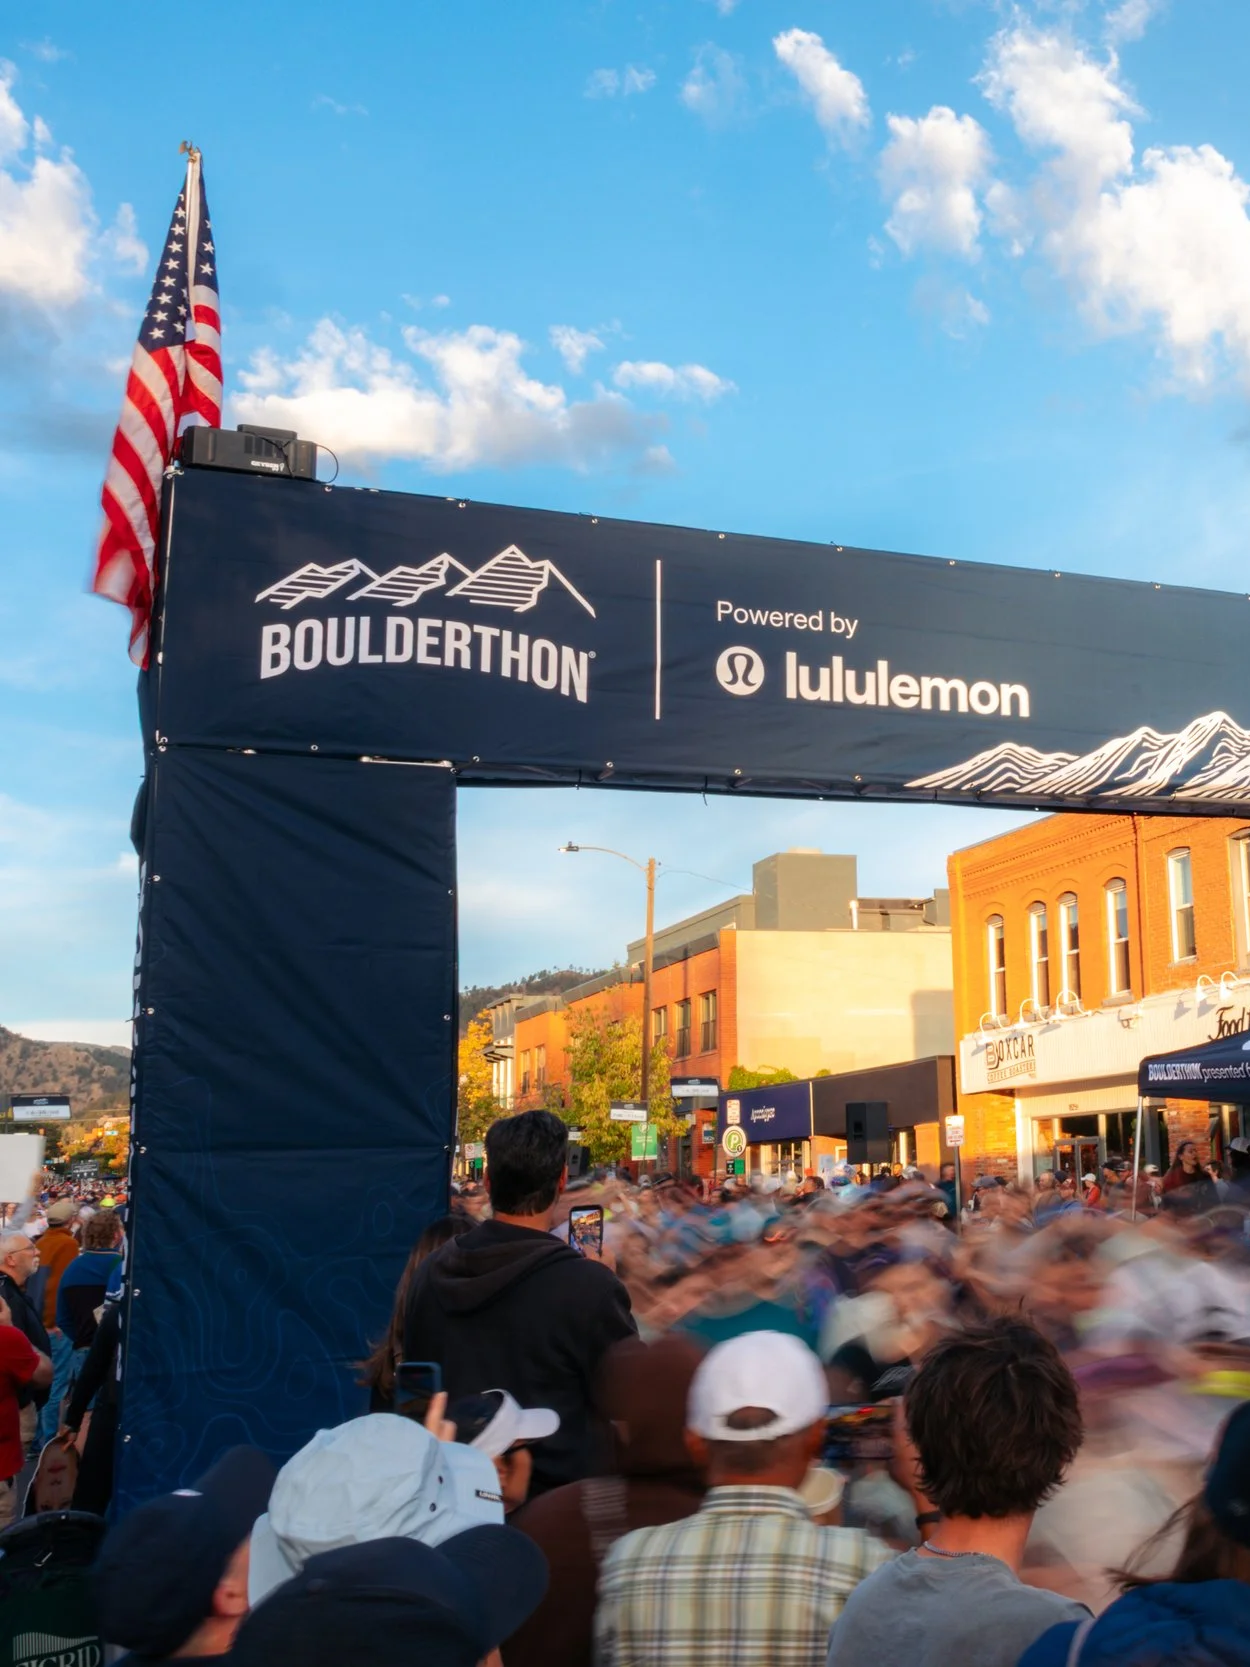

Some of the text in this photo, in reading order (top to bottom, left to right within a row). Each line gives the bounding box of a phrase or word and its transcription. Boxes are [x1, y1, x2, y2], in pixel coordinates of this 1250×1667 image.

[716, 600, 859, 639] Powered by
[786, 651, 1030, 718] lululemon
[1208, 1004, 1246, 1041] Food
[985, 1034, 1035, 1071] BOXCAR
[1148, 1063, 1202, 1081] BOULDERTHON
[1201, 1063, 1245, 1083] presented
